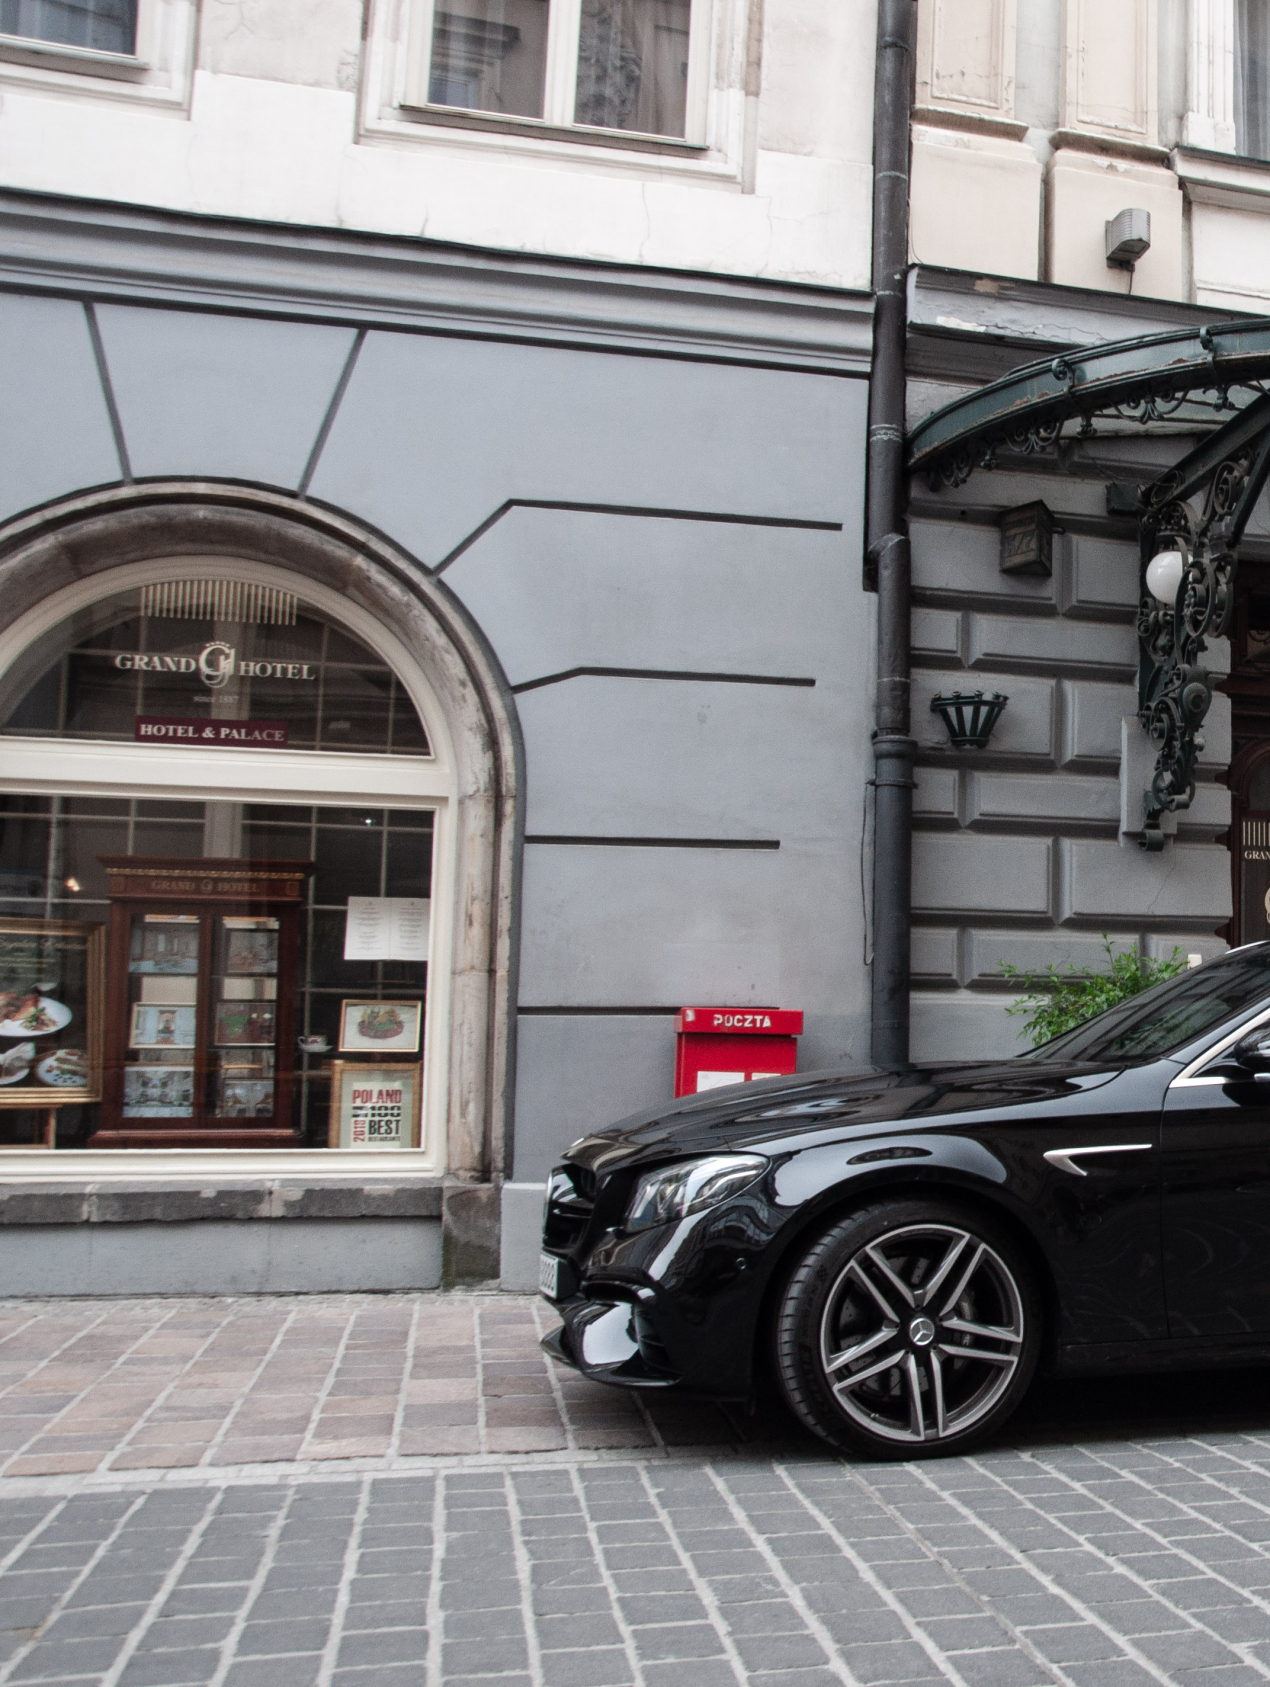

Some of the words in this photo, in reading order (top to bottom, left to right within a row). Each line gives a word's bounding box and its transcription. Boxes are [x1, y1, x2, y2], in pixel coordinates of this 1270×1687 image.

[115, 654, 197, 673] GRAND
[238, 661, 316, 680] HOTEL
[140, 723, 199, 738] HOTEL
[202, 727, 216, 738] &
[219, 727, 285, 741] PALACE
[713, 1014, 771, 1028] POCZTA
[352, 1089, 402, 1104] POLAND
[369, 1105, 401, 1118] 100
[369, 1119, 401, 1135] BEST
